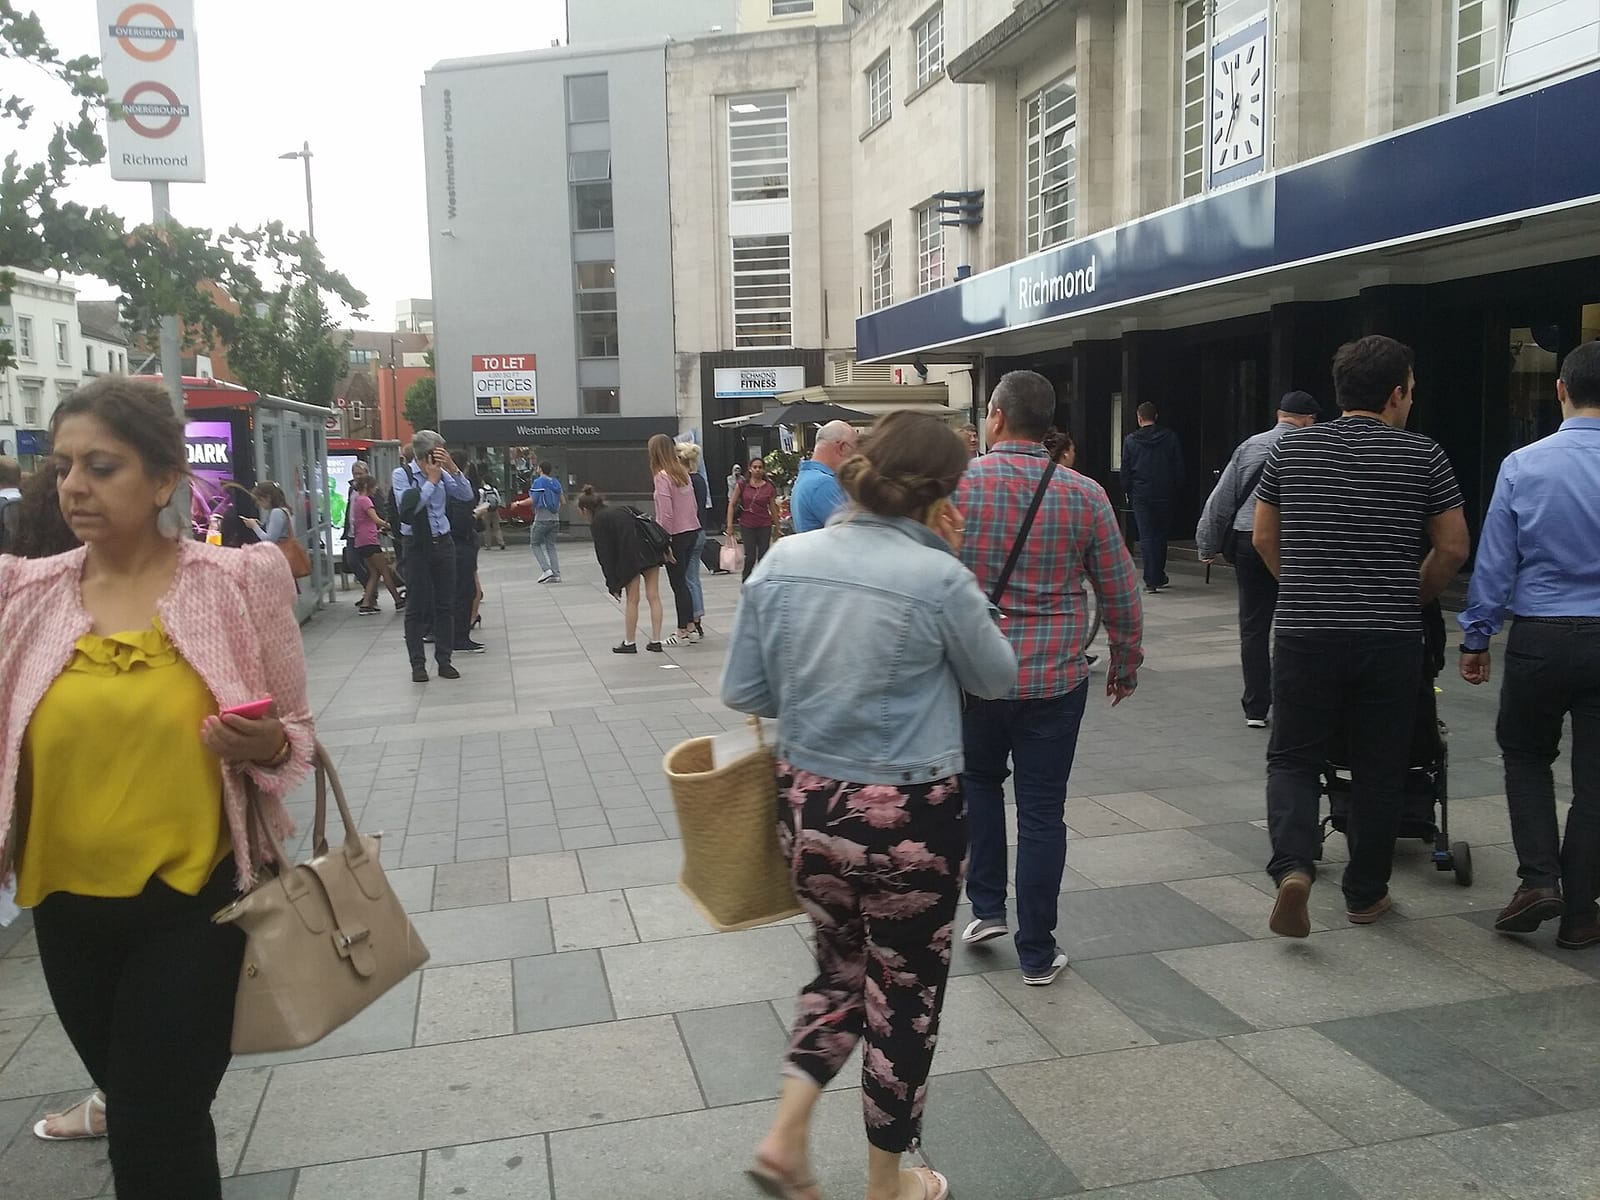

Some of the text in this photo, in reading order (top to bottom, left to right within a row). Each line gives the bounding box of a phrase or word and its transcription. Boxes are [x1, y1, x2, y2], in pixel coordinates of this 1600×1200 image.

[115, 27, 178, 39] OVERGROUND
[122, 153, 188, 167] Richmond
[443, 89, 457, 219] Westminster House
[1018, 254, 1096, 310] Richmond
[481, 357, 526, 370] TO LET
[477, 378, 532, 392] OFFICES
[740, 380, 777, 389] FITNESS
[516, 425, 600, 435] Westminster House
